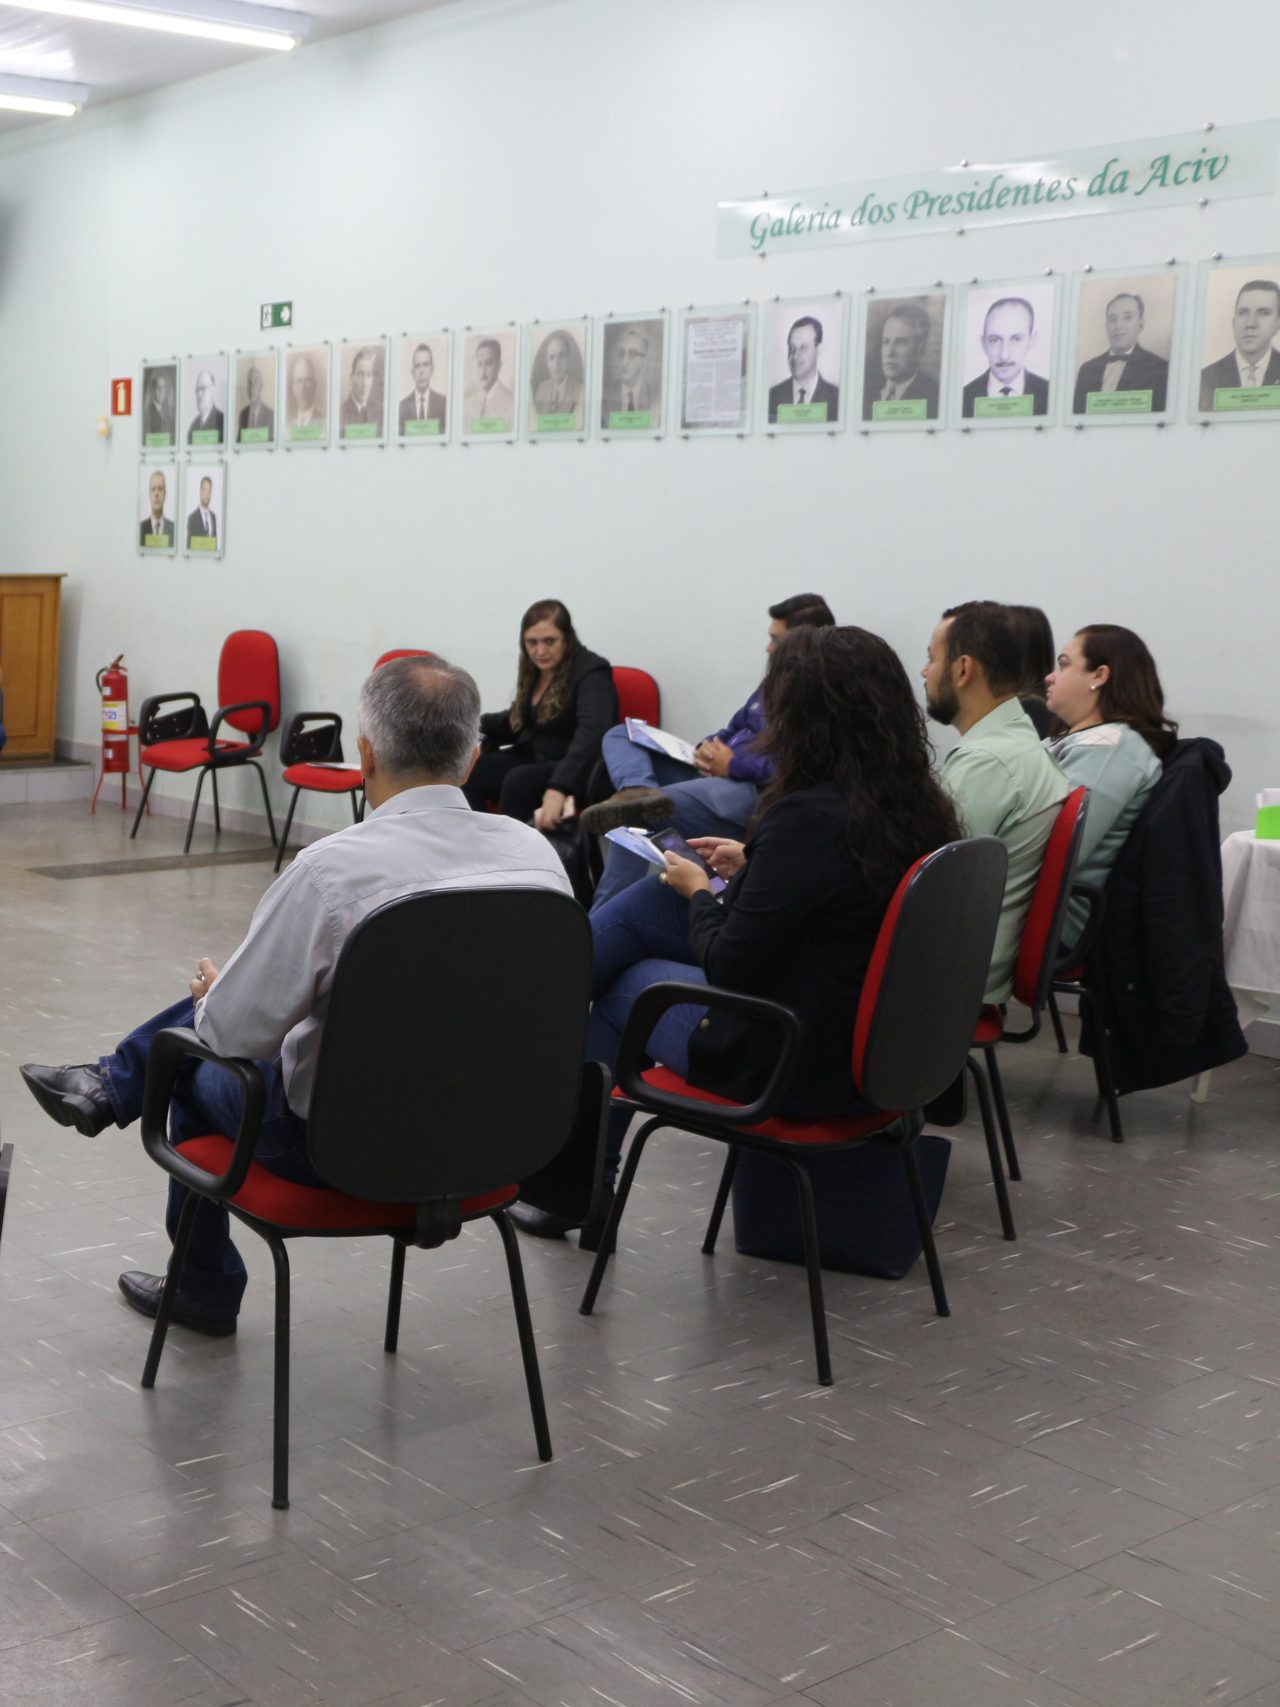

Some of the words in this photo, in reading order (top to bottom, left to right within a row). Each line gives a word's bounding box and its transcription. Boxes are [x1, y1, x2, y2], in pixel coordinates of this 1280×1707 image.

[749, 202, 842, 250] Galeria
[850, 192, 897, 227] dos
[903, 175, 1078, 220] Presidentes
[1087, 158, 1130, 197] da
[1134, 147, 1230, 196] Aciv
